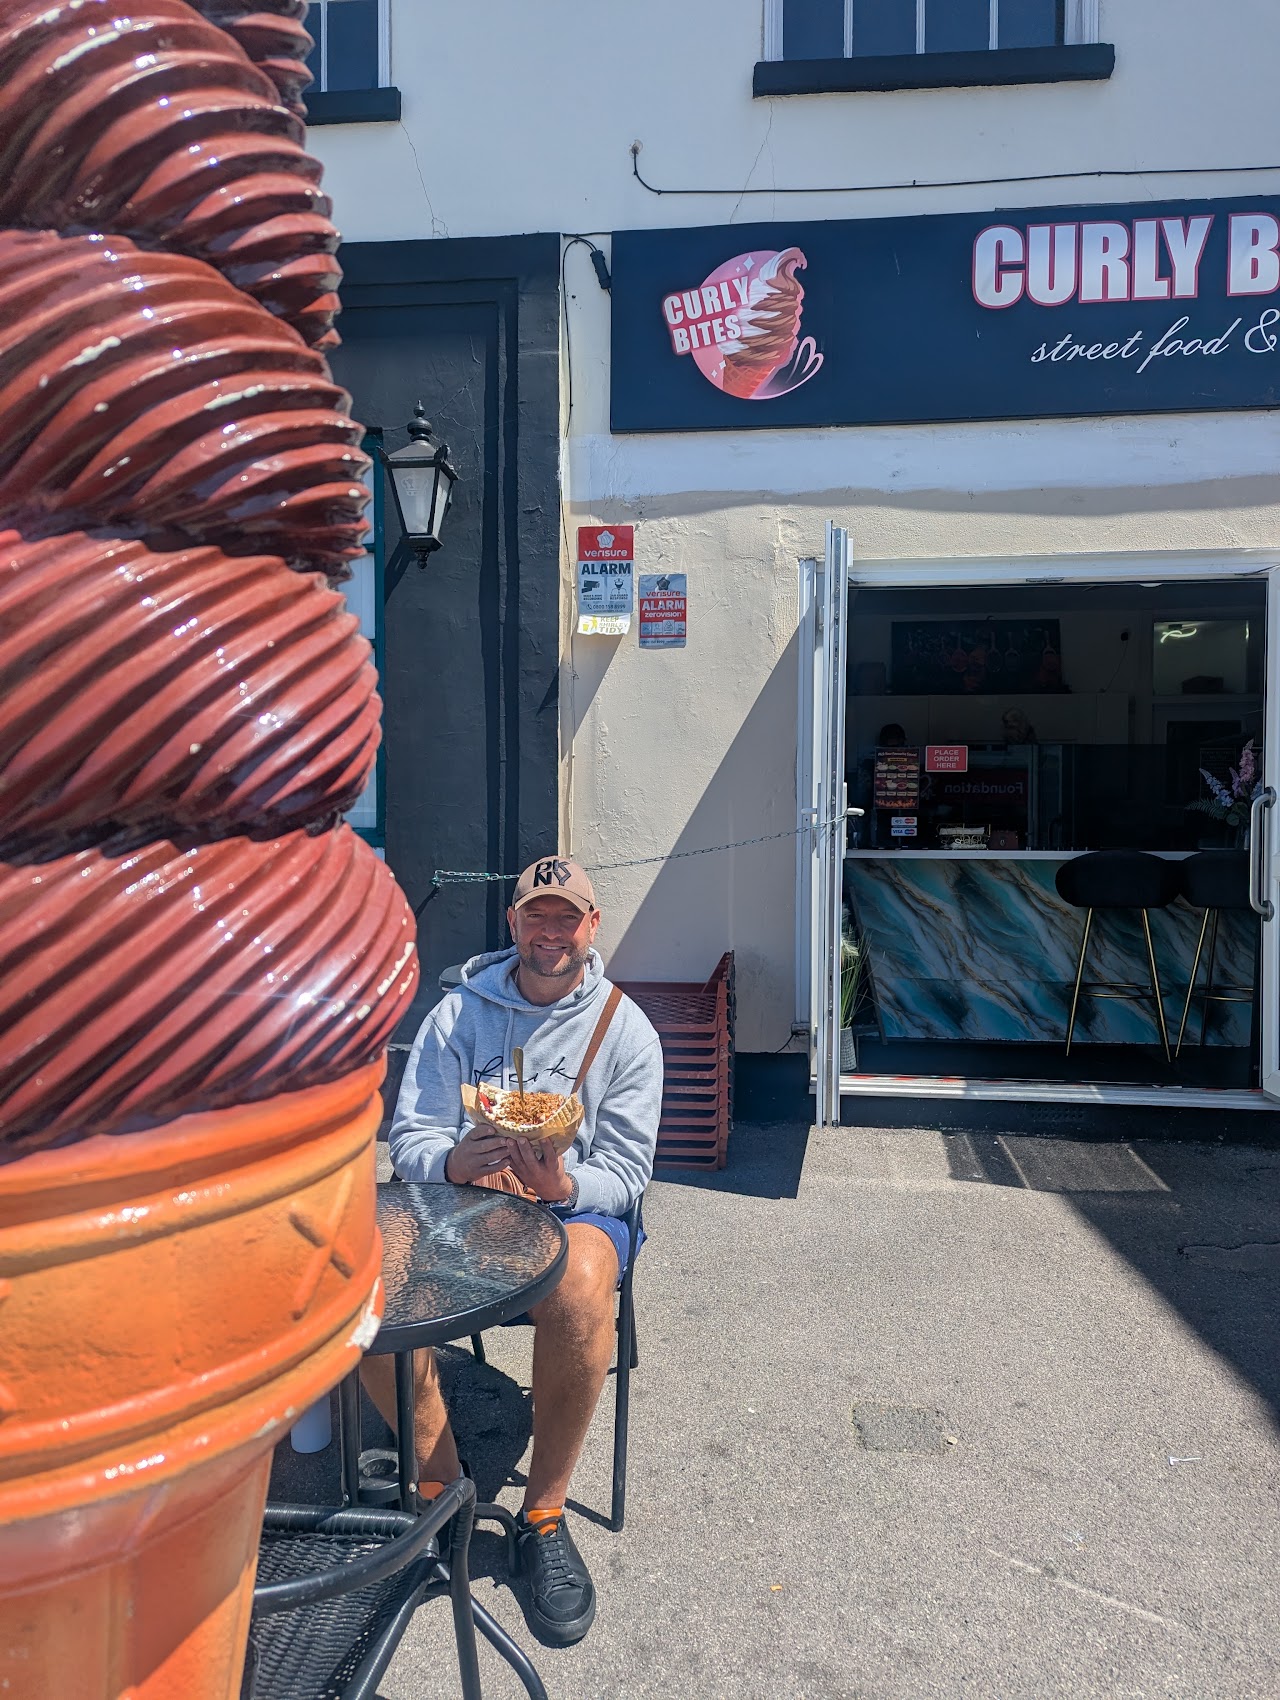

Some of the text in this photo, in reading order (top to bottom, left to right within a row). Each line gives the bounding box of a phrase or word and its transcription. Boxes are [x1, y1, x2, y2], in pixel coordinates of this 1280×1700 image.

[973, 214, 1215, 309] CURLY
[662, 275, 752, 327] CURLY
[671, 314, 742, 355] BITES
[1031, 308, 1280, 374] street food &
[581, 562, 631, 575] ALARM
[584, 549, 628, 557] verisure
[642, 599, 685, 611] ALARM
